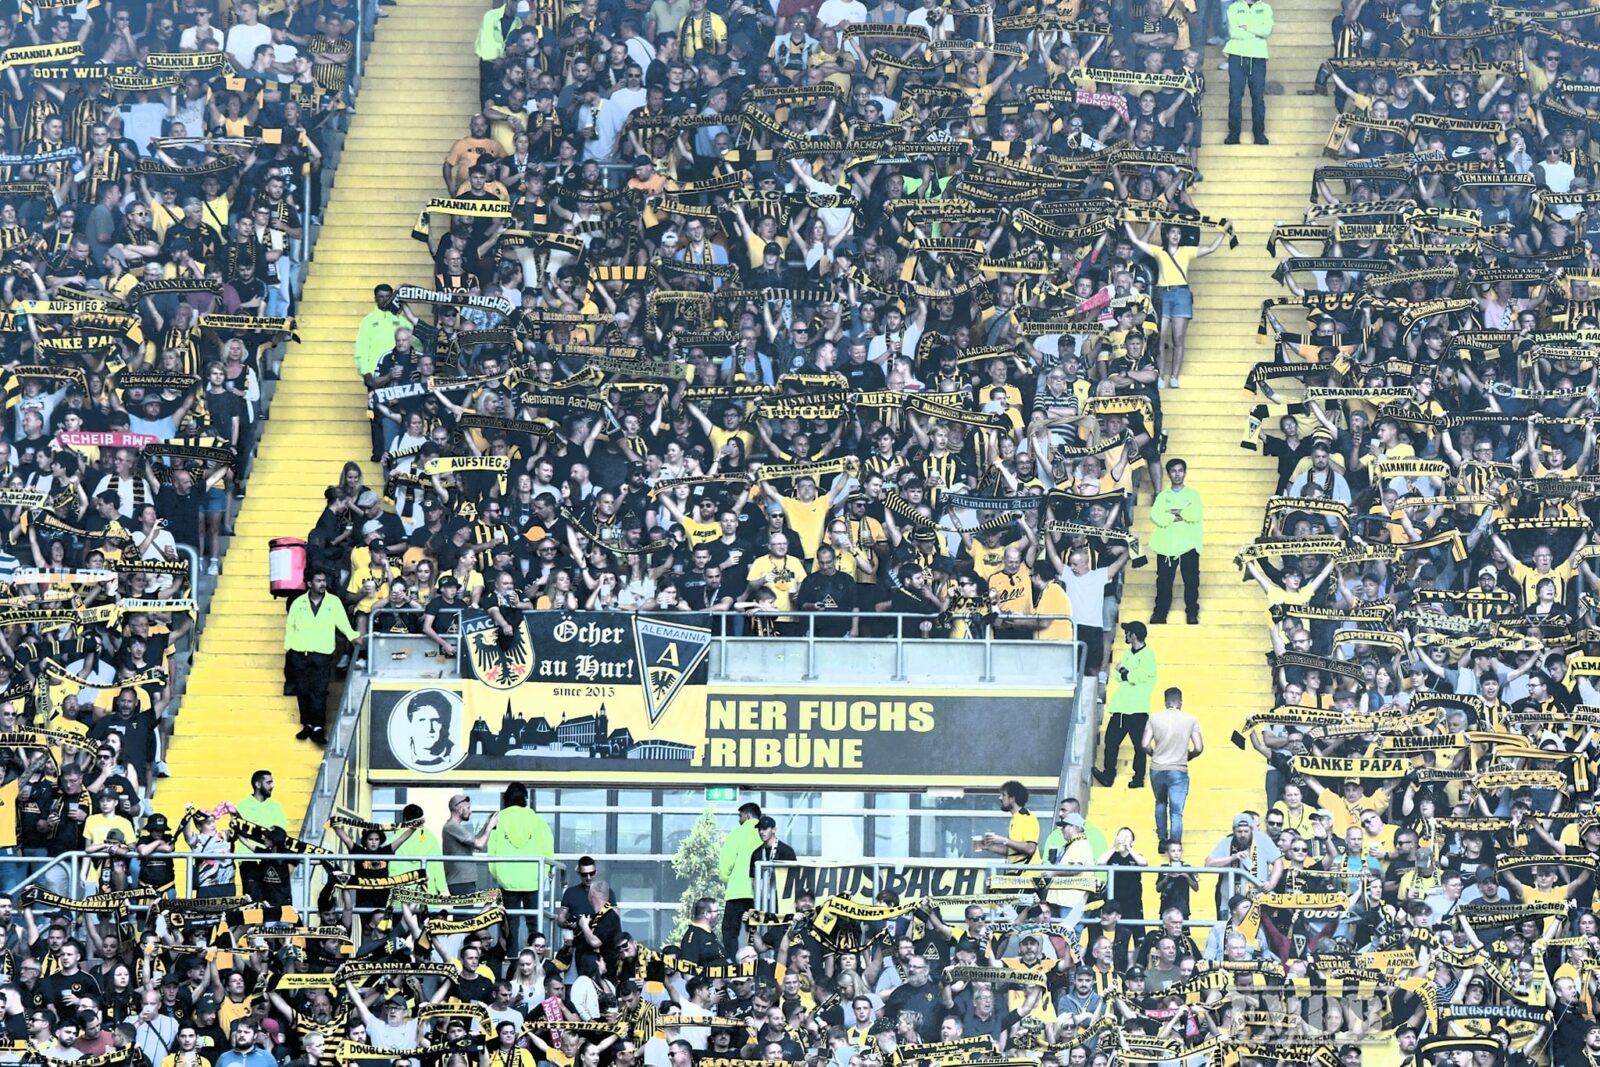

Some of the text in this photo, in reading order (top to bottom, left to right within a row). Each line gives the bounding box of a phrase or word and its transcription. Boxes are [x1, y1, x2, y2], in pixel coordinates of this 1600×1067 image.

[1416, 62, 1501, 71] AACHEN
[33, 68, 69, 78] GOTT
[1086, 68, 1184, 84] Alemannia Aachen
[1076, 91, 1087, 99] FC
[986, 153, 1044, 173] ALEMANNIA
[431, 199, 477, 211] EMANNIA
[1313, 260, 1338, 269] Jahre
[1341, 260, 1388, 270] Alemannia
[48, 300, 97, 311] AUFSTIEG
[1023, 322, 1104, 332] Alemannia Aachen
[120, 376, 161, 384] ALEMANNIA
[378, 383, 424, 403] FORZA
[735, 385, 771, 393] PAPA
[1310, 388, 1369, 397] ALEMANNIA
[522, 392, 602, 411] Alemannia Aachen
[61, 433, 114, 446] SCHEIB
[451, 456, 503, 468] AUFSTIEG
[766, 458, 840, 474] ALEMANNIA
[1264, 540, 1343, 552] ALEMANNIA
[1420, 591, 1510, 601] TIVOLI
[1288, 605, 1346, 617] ALEMANNIA
[466, 617, 496, 631] AAC
[550, 616, 625, 646] Öcher
[641, 625, 707, 644] ALEMANNIA
[656, 643, 679, 667] A
[540, 656, 634, 680] au Hur!
[553, 686, 616, 698] since 2015
[710, 701, 935, 732] NER FUCHS
[1392, 735, 1456, 747] ALEMANNIA
[1300, 756, 1403, 771] DANKE PAPA
[782, 868, 977, 900] MAUSBACH
[345, 963, 412, 972] ALEMANNIA
[1316, 960, 1351, 969] KERKRADE
[1387, 958, 1415, 967] AACHEN
